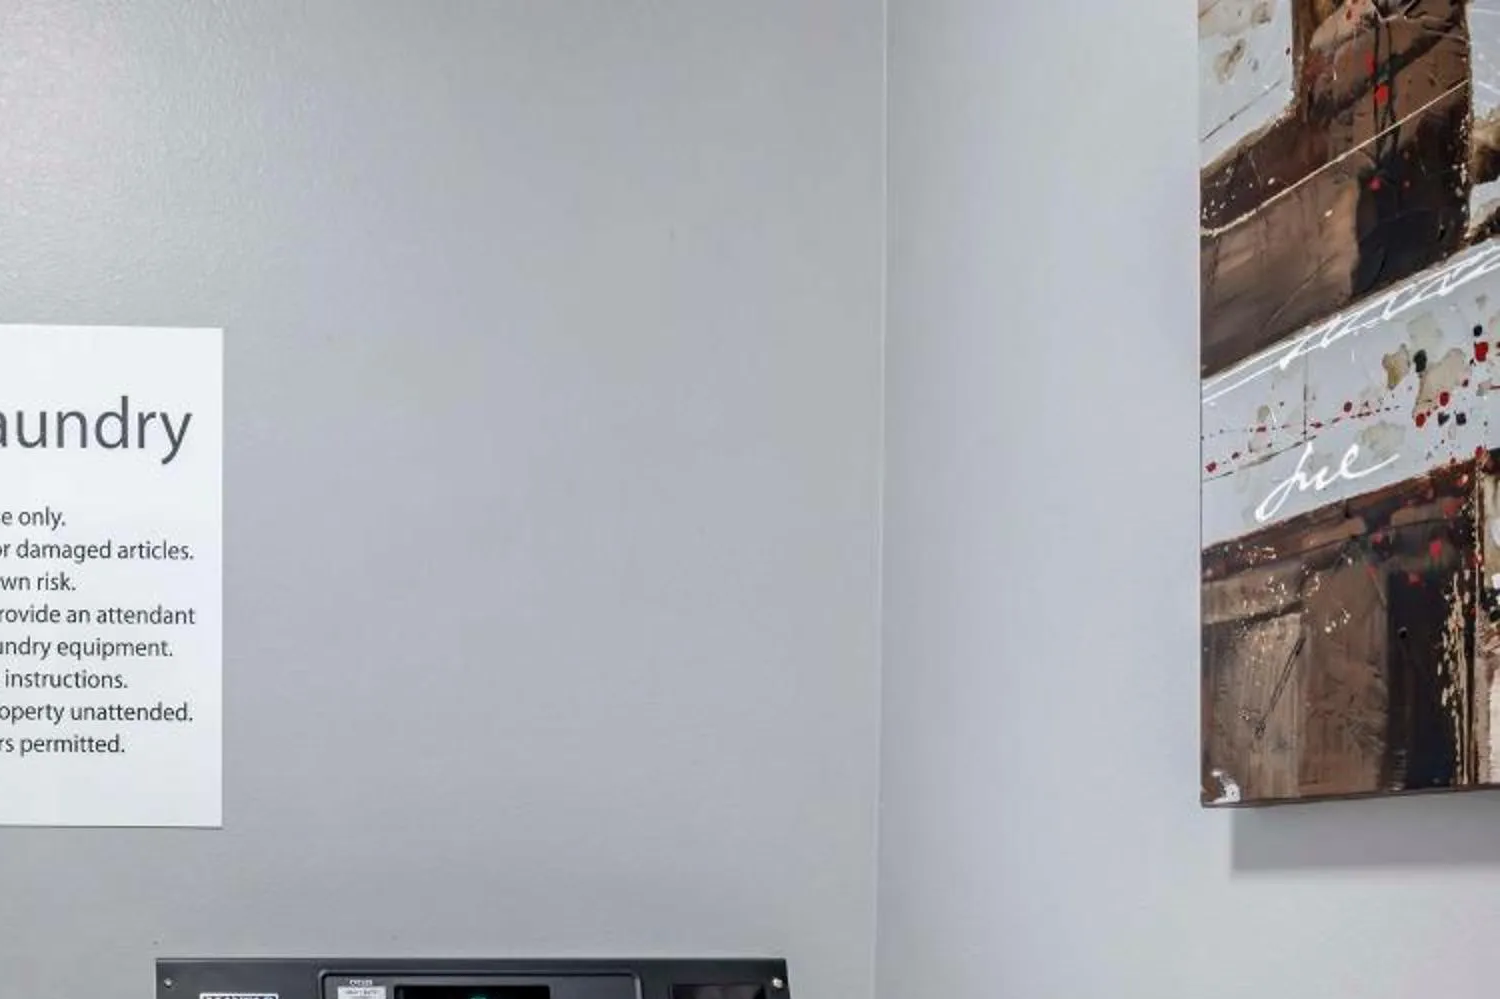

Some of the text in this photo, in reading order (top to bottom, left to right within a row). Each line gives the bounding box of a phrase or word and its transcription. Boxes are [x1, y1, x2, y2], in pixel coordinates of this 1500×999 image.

[17, 505, 67, 532] only.
[15, 537, 112, 565] damaged
[116, 539, 195, 561] articles.
[36, 571, 77, 592] risk.
[65, 608, 92, 625] an
[95, 603, 197, 625] attendant
[56, 637, 173, 662] equipment.
[4, 668, 129, 689] instructions.
[69, 701, 194, 723] unattended.
[19, 733, 126, 758] permitted.
